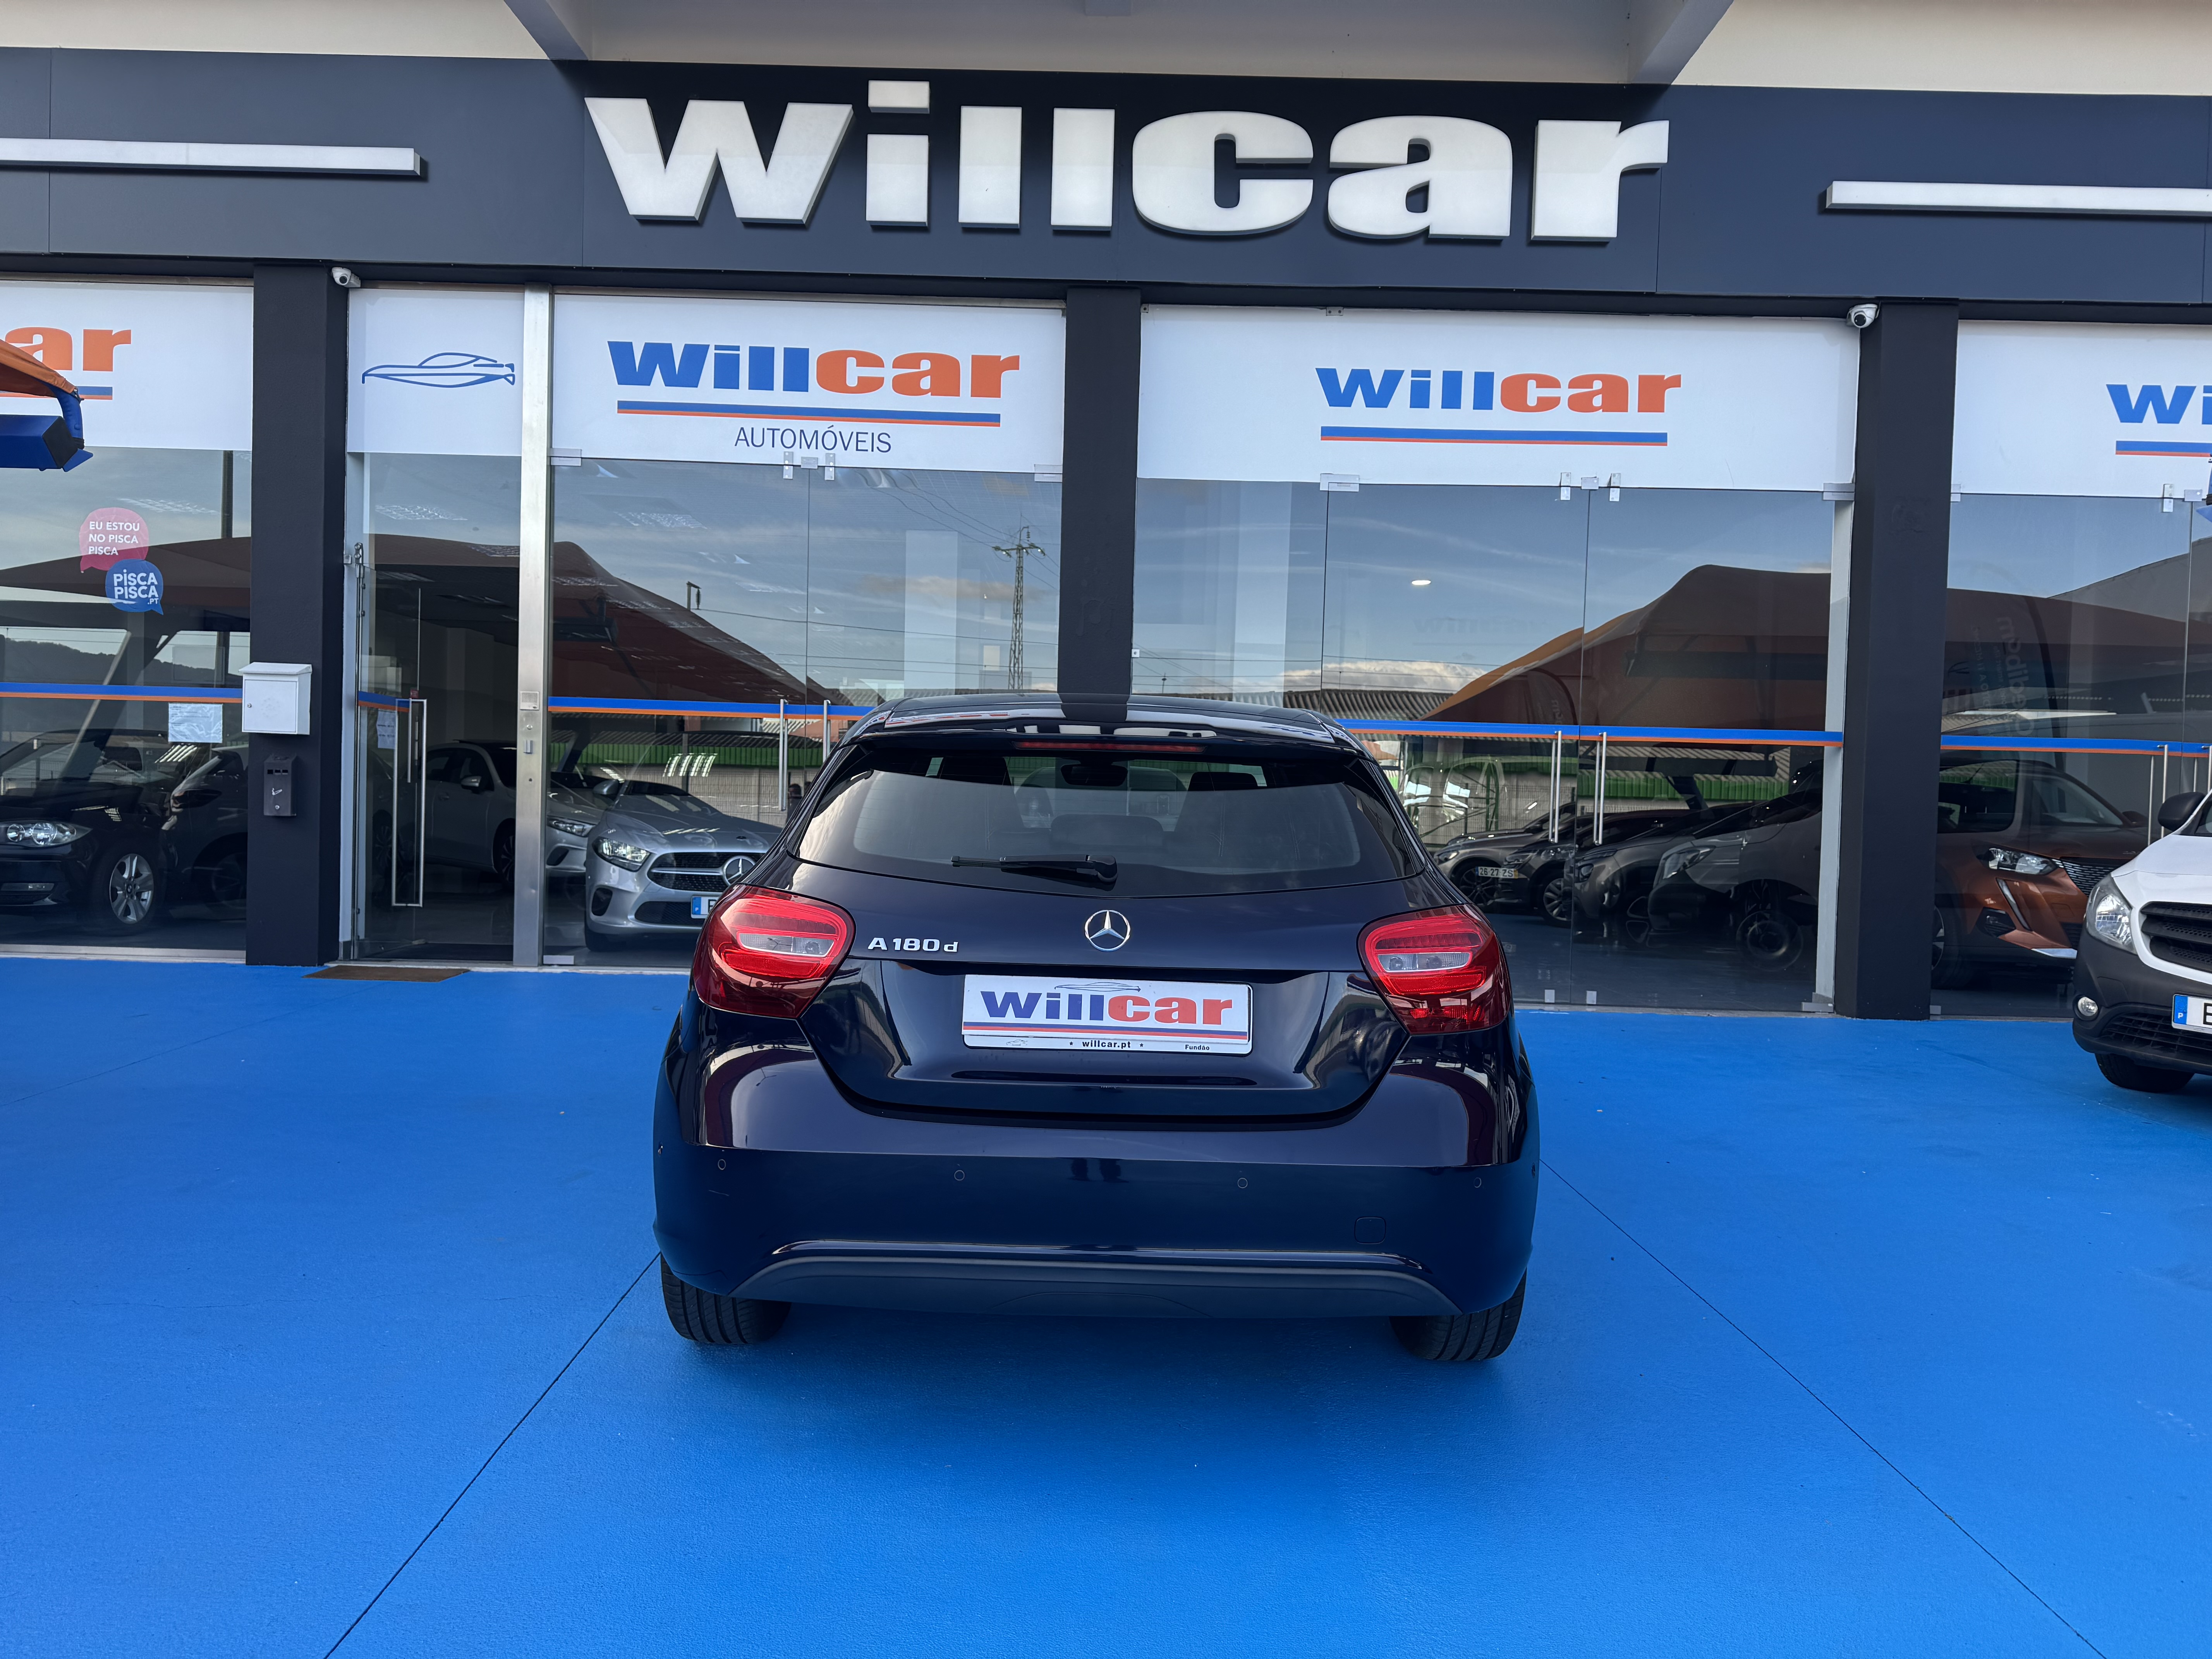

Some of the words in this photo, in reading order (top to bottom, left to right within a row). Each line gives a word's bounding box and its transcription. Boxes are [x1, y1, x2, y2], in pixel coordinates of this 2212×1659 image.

[584, 79, 1670, 241] willcar
[607, 341, 1020, 398] willcar
[1316, 368, 1681, 413] willcar
[734, 425, 892, 453] AUTOMÓVEIS
[89, 521, 103, 530] EU
[106, 522, 140, 531] ESTOU
[89, 534, 105, 542] NO
[108, 535, 139, 544] PISCA
[88, 546, 118, 555] PISCA
[114, 586, 159, 599] PISCA
[868, 938, 888, 950] A
[893, 938, 940, 951] 180
[944, 941, 958, 952] d
[980, 991, 1232, 1025] willcar
[1082, 1040, 1131, 1049] willcar.pt
